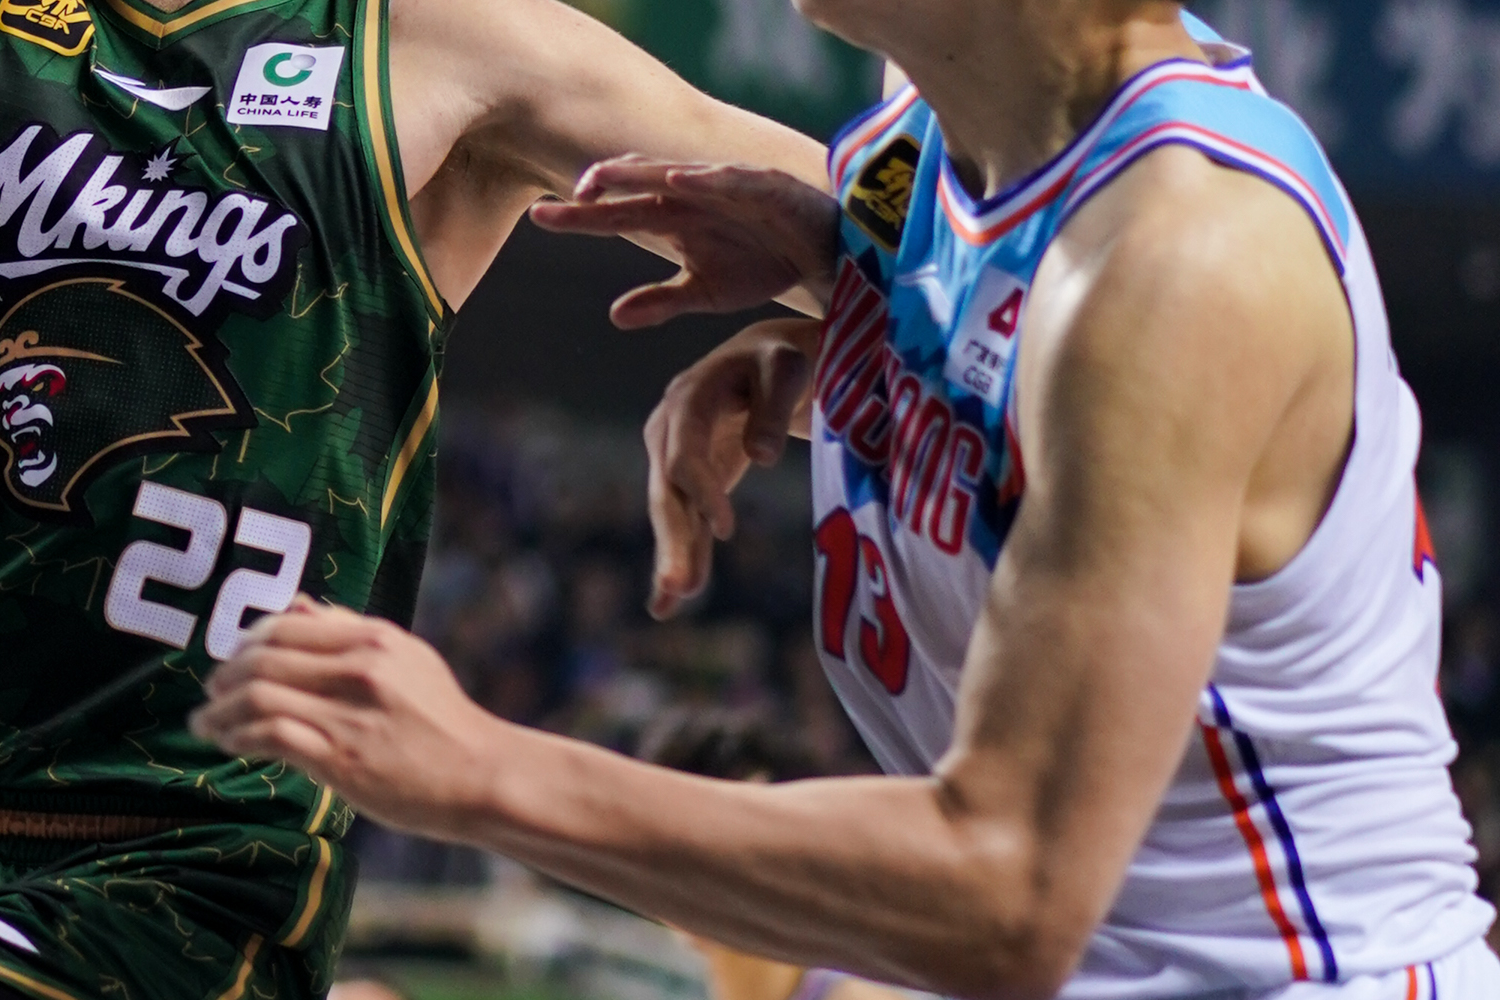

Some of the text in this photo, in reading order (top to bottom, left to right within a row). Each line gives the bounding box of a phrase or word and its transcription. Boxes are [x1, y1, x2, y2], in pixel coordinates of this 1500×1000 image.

[25, 8, 70, 35] CBA
[236, 107, 319, 119] CHINA LIFE
[239, 92, 322, 109] 中国人寿
[104, 479, 312, 661] 22
[814, 506, 910, 697] 13
